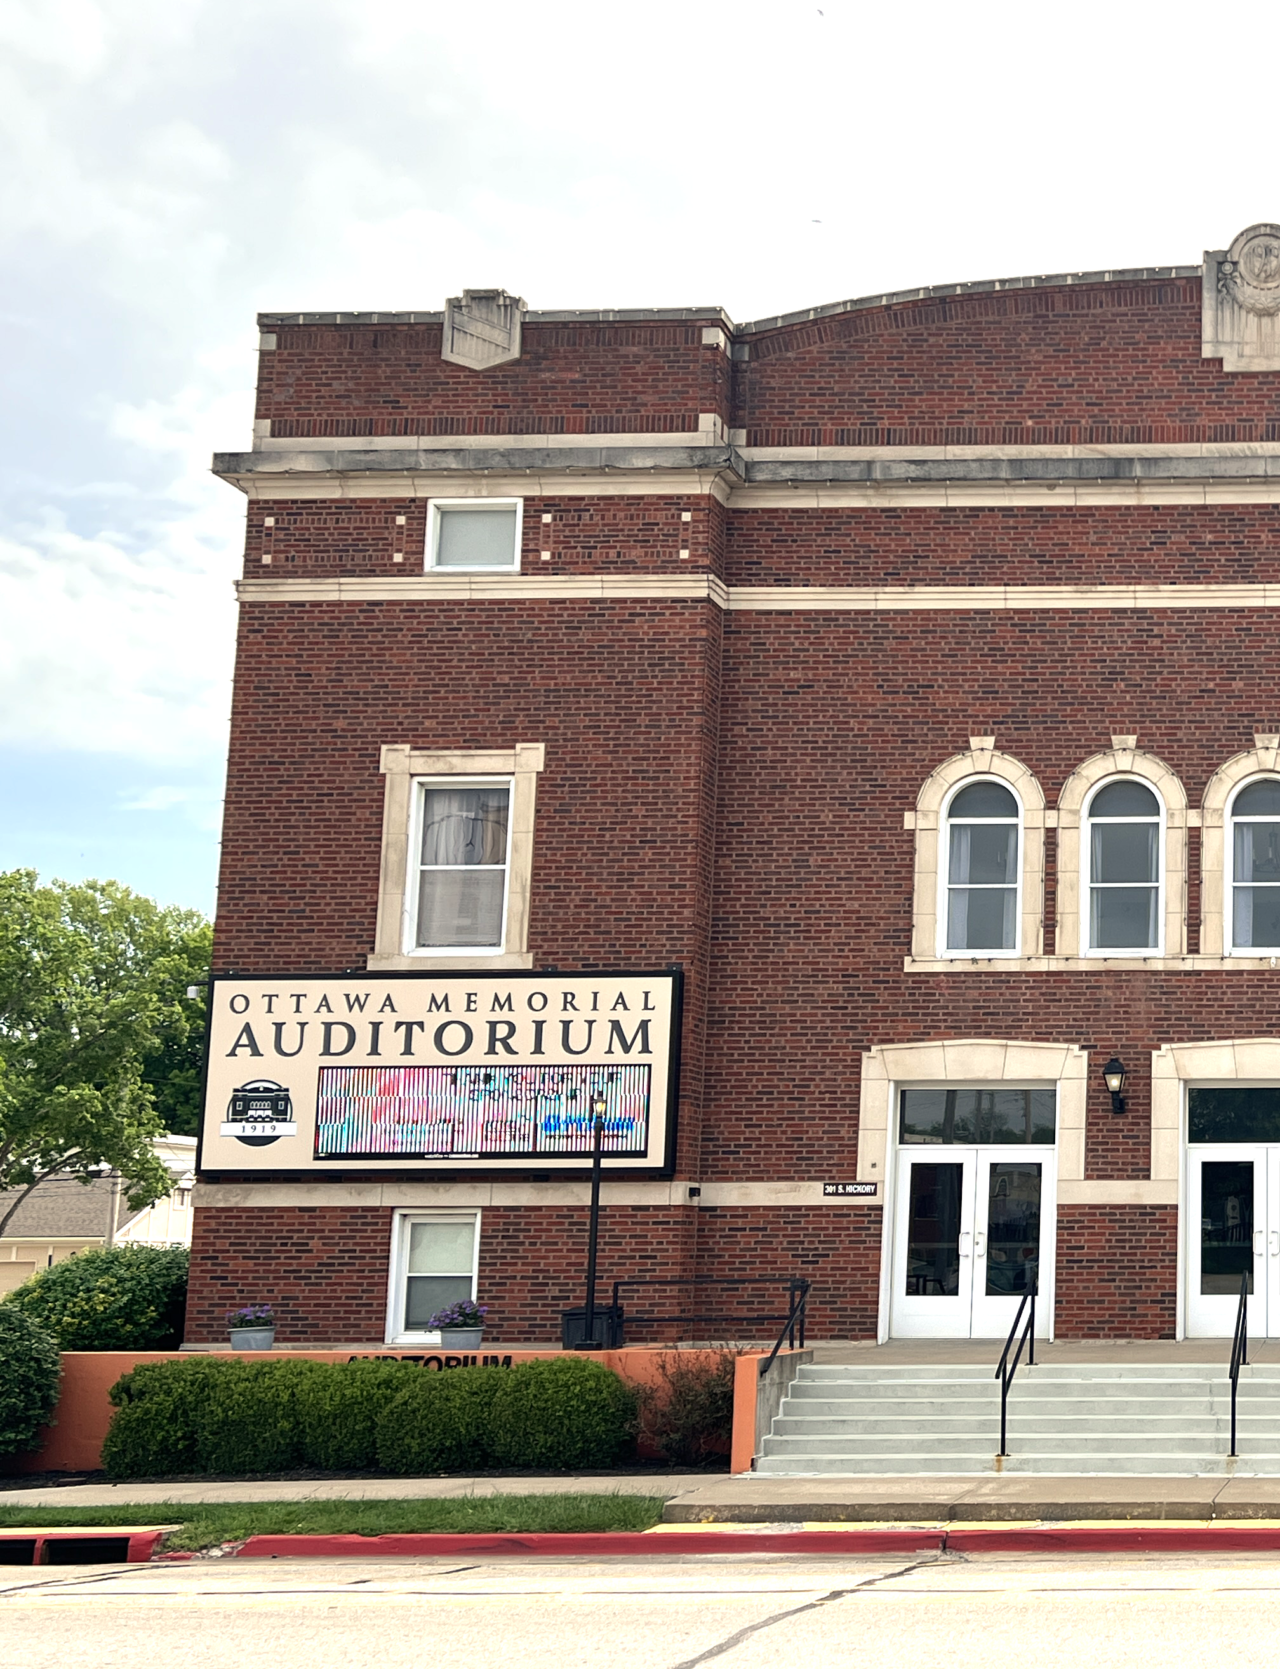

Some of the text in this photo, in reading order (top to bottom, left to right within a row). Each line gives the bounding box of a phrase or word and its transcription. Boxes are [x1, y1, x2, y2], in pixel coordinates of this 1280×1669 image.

[229, 991, 655, 1014] OTTAWA MEMORIAL
[225, 1018, 653, 1057] AUDITORIUM
[241, 1124, 277, 1134] 1919
[824, 1184, 876, 1194] 301 S. HICKORY
[347, 1355, 513, 1371] TORIUM
